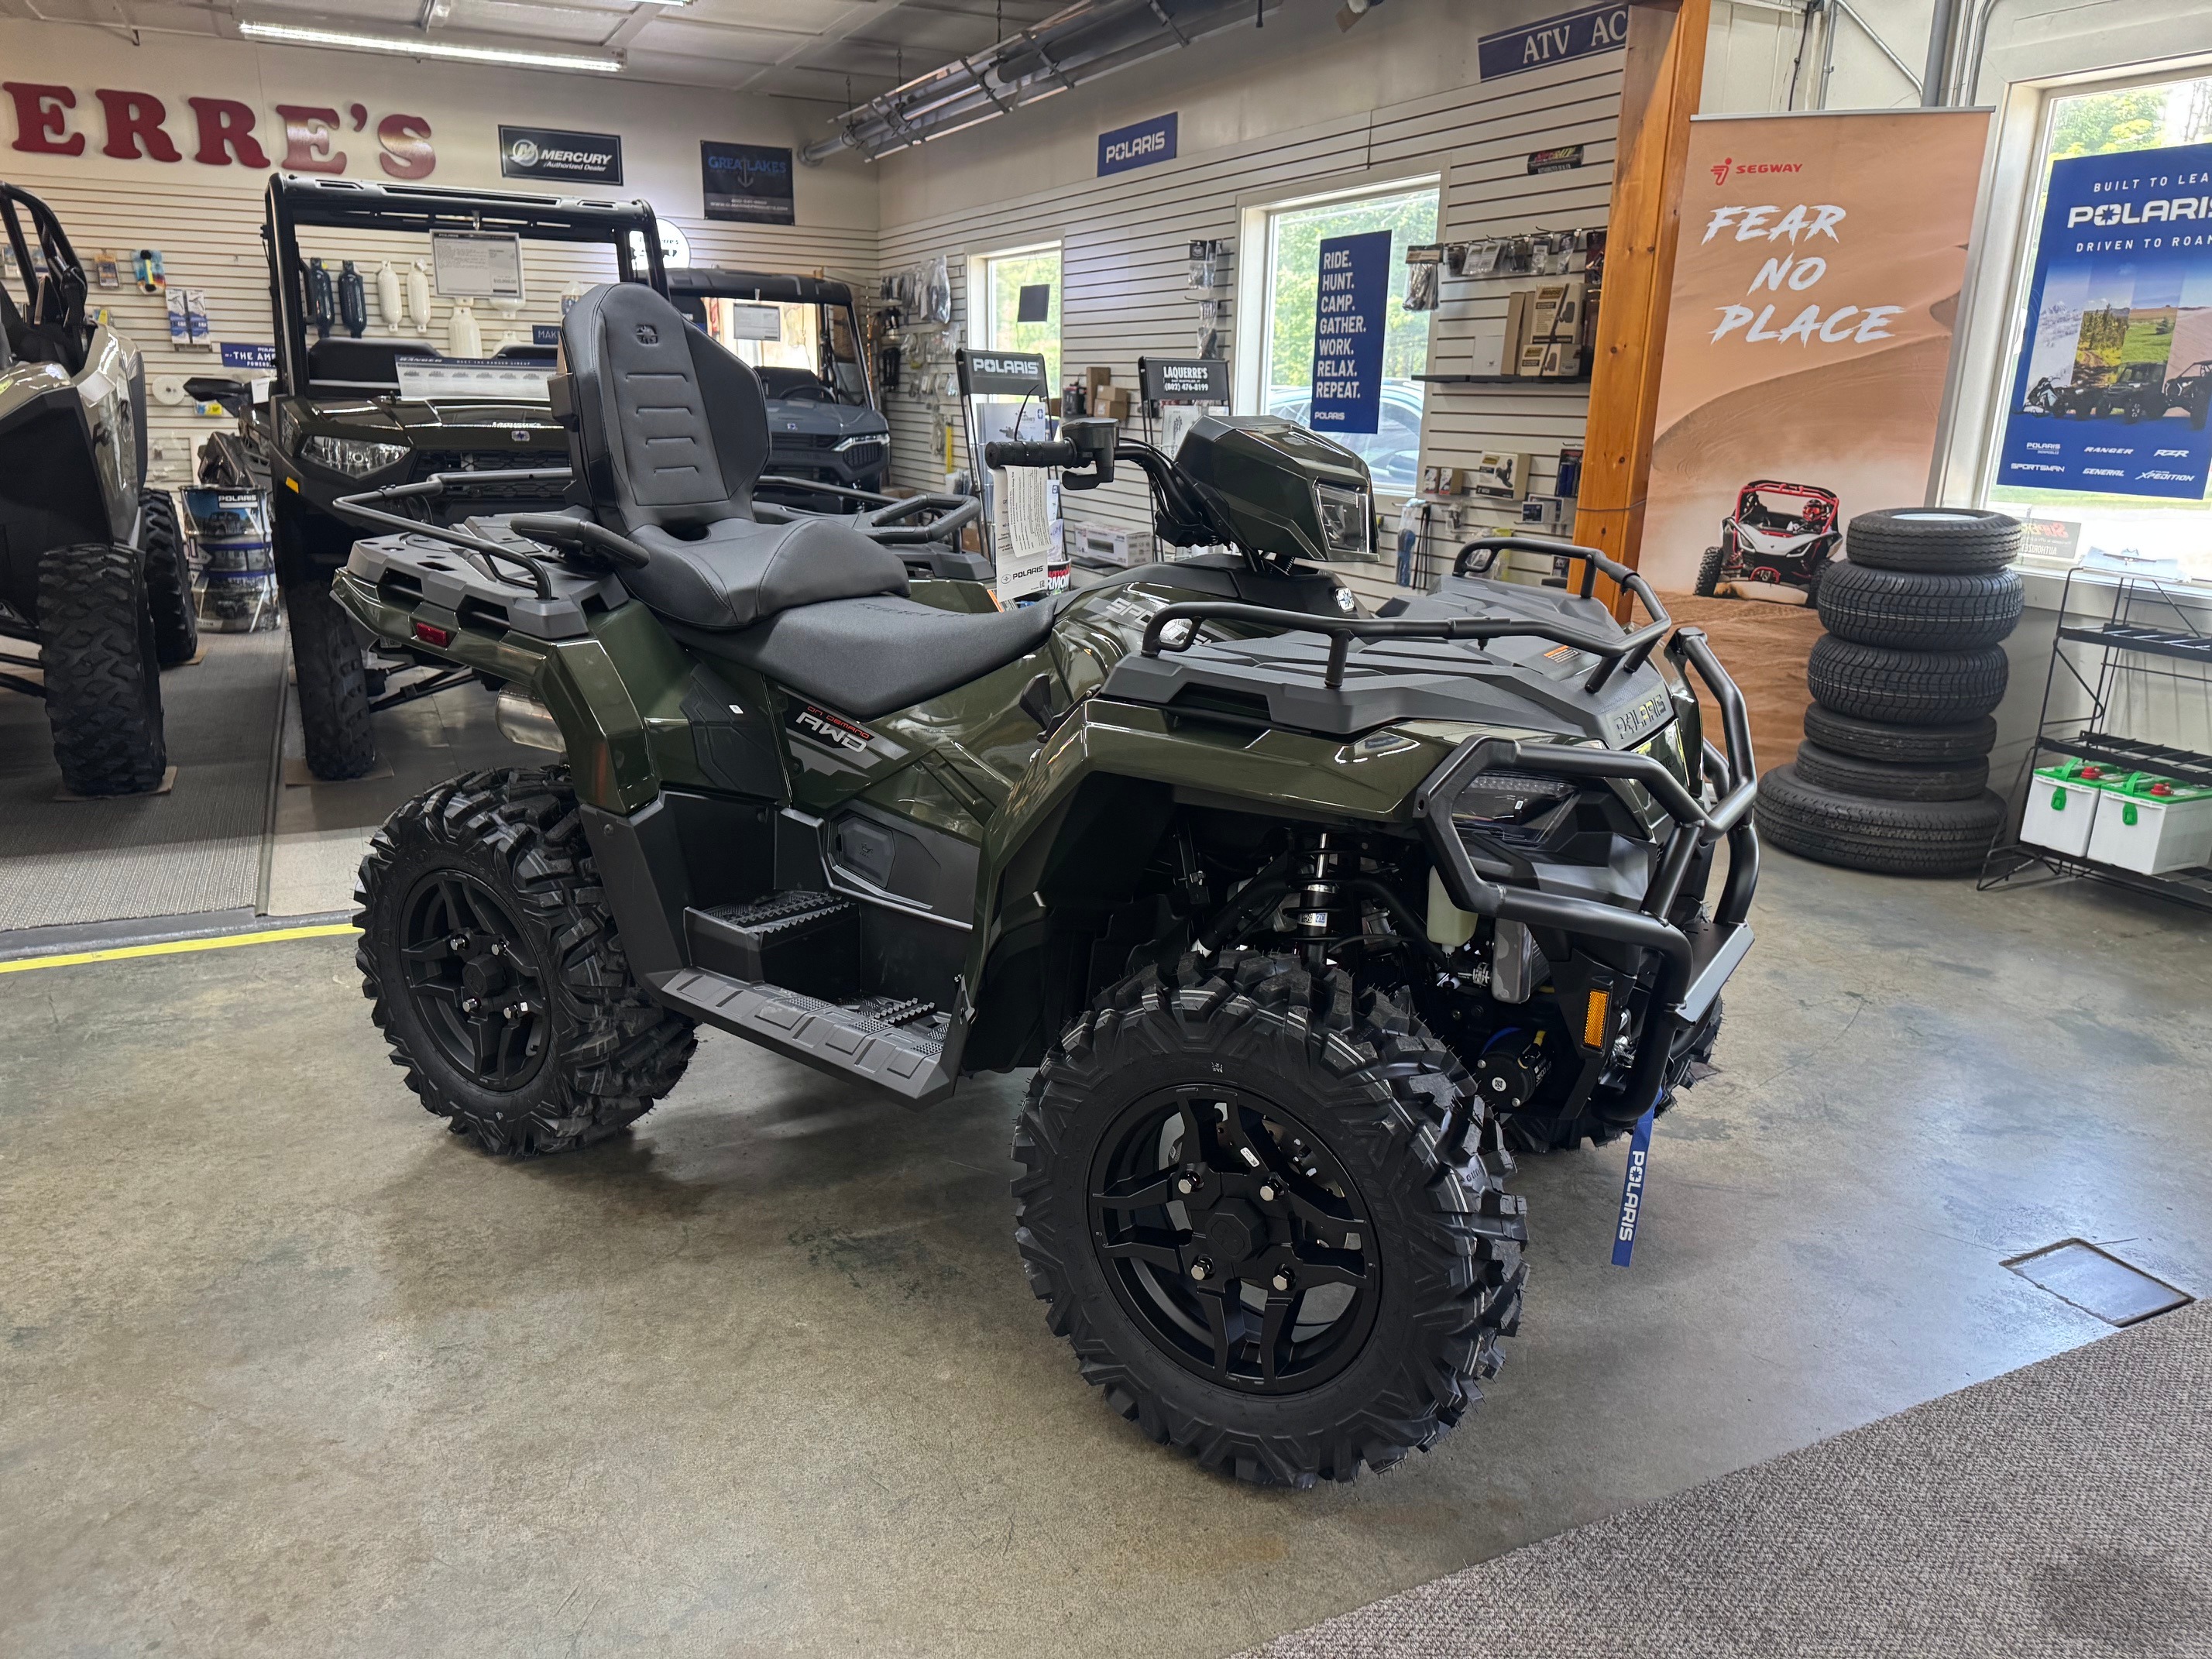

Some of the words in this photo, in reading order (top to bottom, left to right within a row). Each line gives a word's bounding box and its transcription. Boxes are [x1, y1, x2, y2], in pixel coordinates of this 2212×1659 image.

[1523, 25, 1571, 64] ATV
[2, 81, 436, 180] ERRE'S
[1105, 130, 1166, 164] POLARIS
[541, 149, 612, 165] MERCURY
[547, 161, 582, 170] Authorized
[747, 160, 786, 173] LAKES
[1736, 163, 1802, 174] SEGWAY
[2094, 179, 2139, 193] BUILT
[2150, 177, 2168, 187] TO
[2067, 196, 2212, 228] POLARI
[1701, 204, 1846, 246] FEAR
[2076, 239, 2134, 252] DRIVEN
[2144, 238, 2162, 249] TO
[1323, 250, 1352, 270] RIDE.
[1321, 272, 1355, 291] HUNT.
[1747, 250, 1826, 297] NO
[1321, 294, 1355, 313] CAMP.
[1319, 315, 1367, 335] GATHER.
[1707, 303, 1908, 349] PLACE
[1318, 338, 1355, 356] WORK.
[233, 351, 253, 361] THE
[973, 358, 1039, 375] POLARIS
[1163, 366, 1208, 380] LAQUERRE'S
[1317, 359, 1358, 377] RELAX.
[1165, 383, 1180, 392] (802)
[1316, 381, 1361, 399] REPEAT.
[1314, 411, 1345, 421] POLARIS
[2083, 446, 2134, 455] RANGER
[2154, 449, 2190, 458] RZR
[2011, 462, 2065, 472] SPORTSMAN
[2083, 468, 2124, 477] GENERAL
[2135, 470, 2196, 482] XPEDITION
[218, 494, 257, 503] POLARIS
[1012, 566, 1044, 580] POLARIS
[807, 706, 823, 716] ON
[826, 713, 871, 740] DEMAND
[1613, 694, 1667, 740] POLARIS
[795, 711, 867, 753] AWD
[1619, 1150, 1646, 1242] POLARIS
